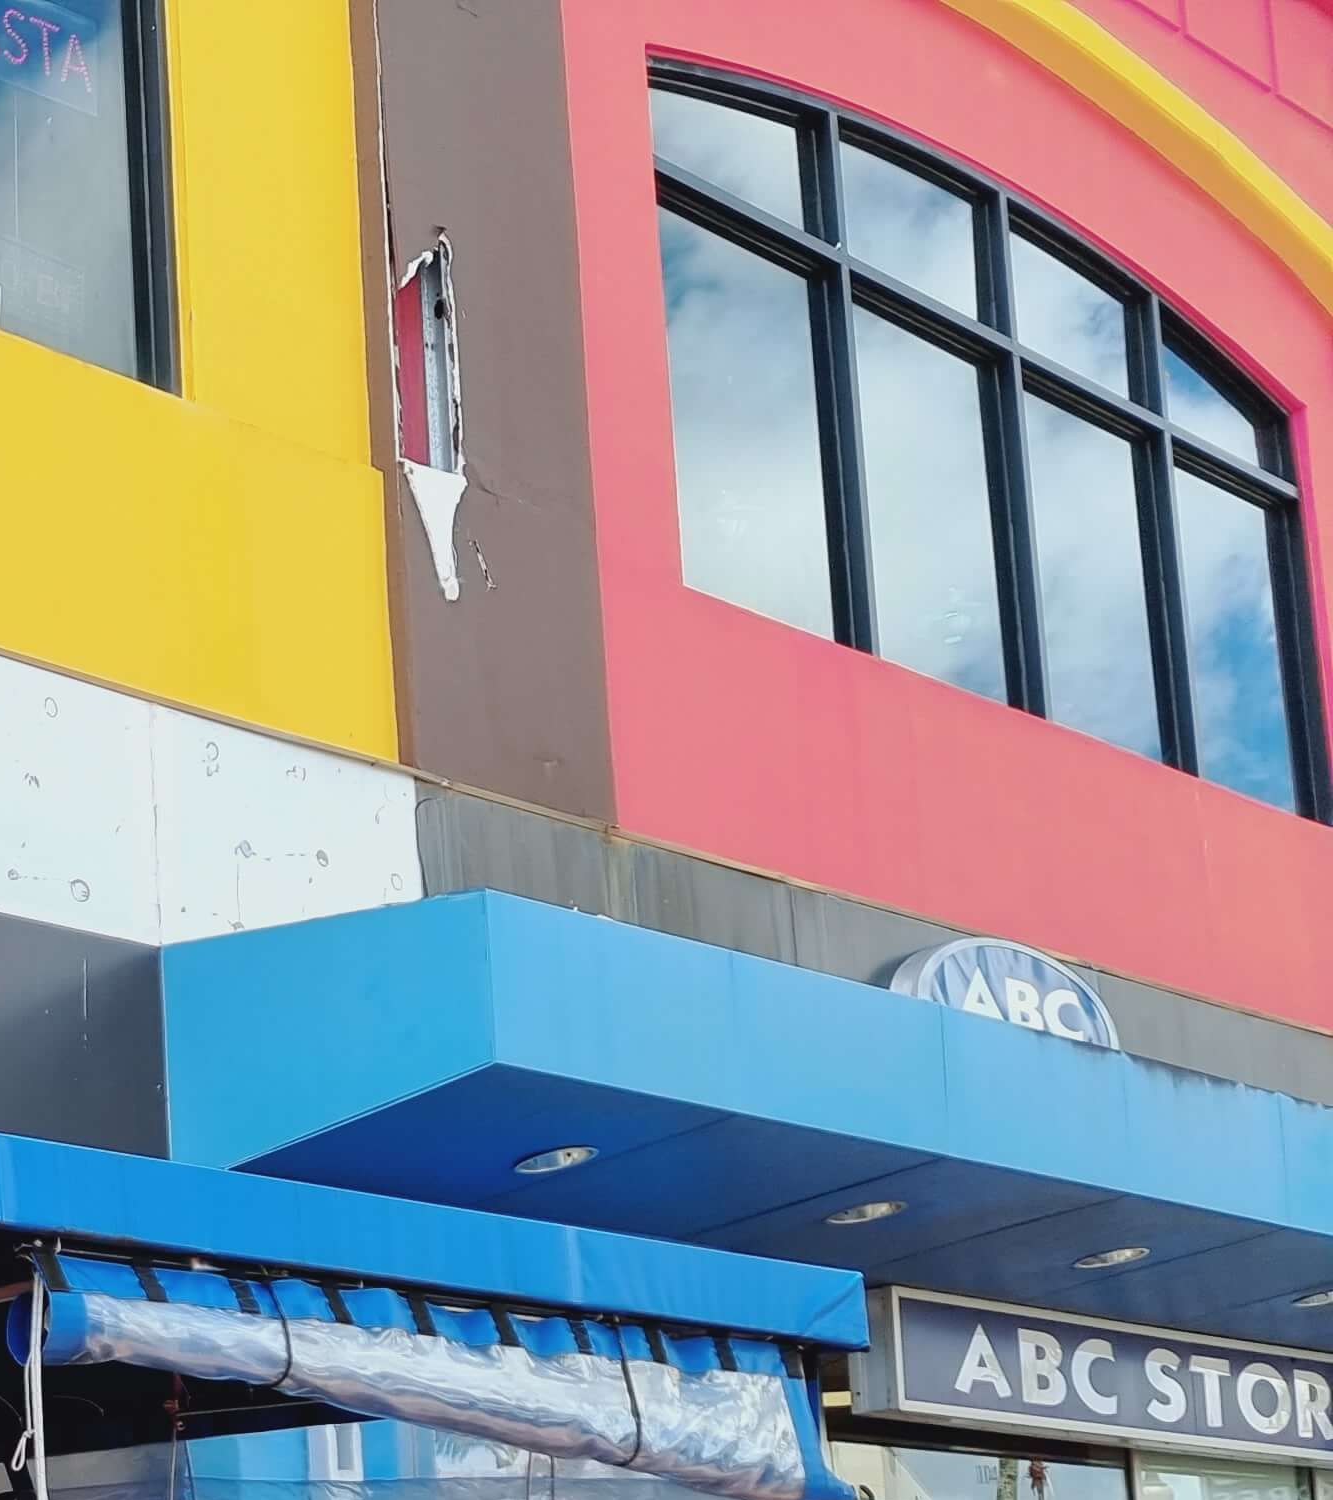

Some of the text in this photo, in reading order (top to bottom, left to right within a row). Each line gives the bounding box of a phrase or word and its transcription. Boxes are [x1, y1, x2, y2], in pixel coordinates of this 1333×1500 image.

[961, 965, 1085, 1042] ABC
[953, 1323, 1333, 1441] ABC STOR
